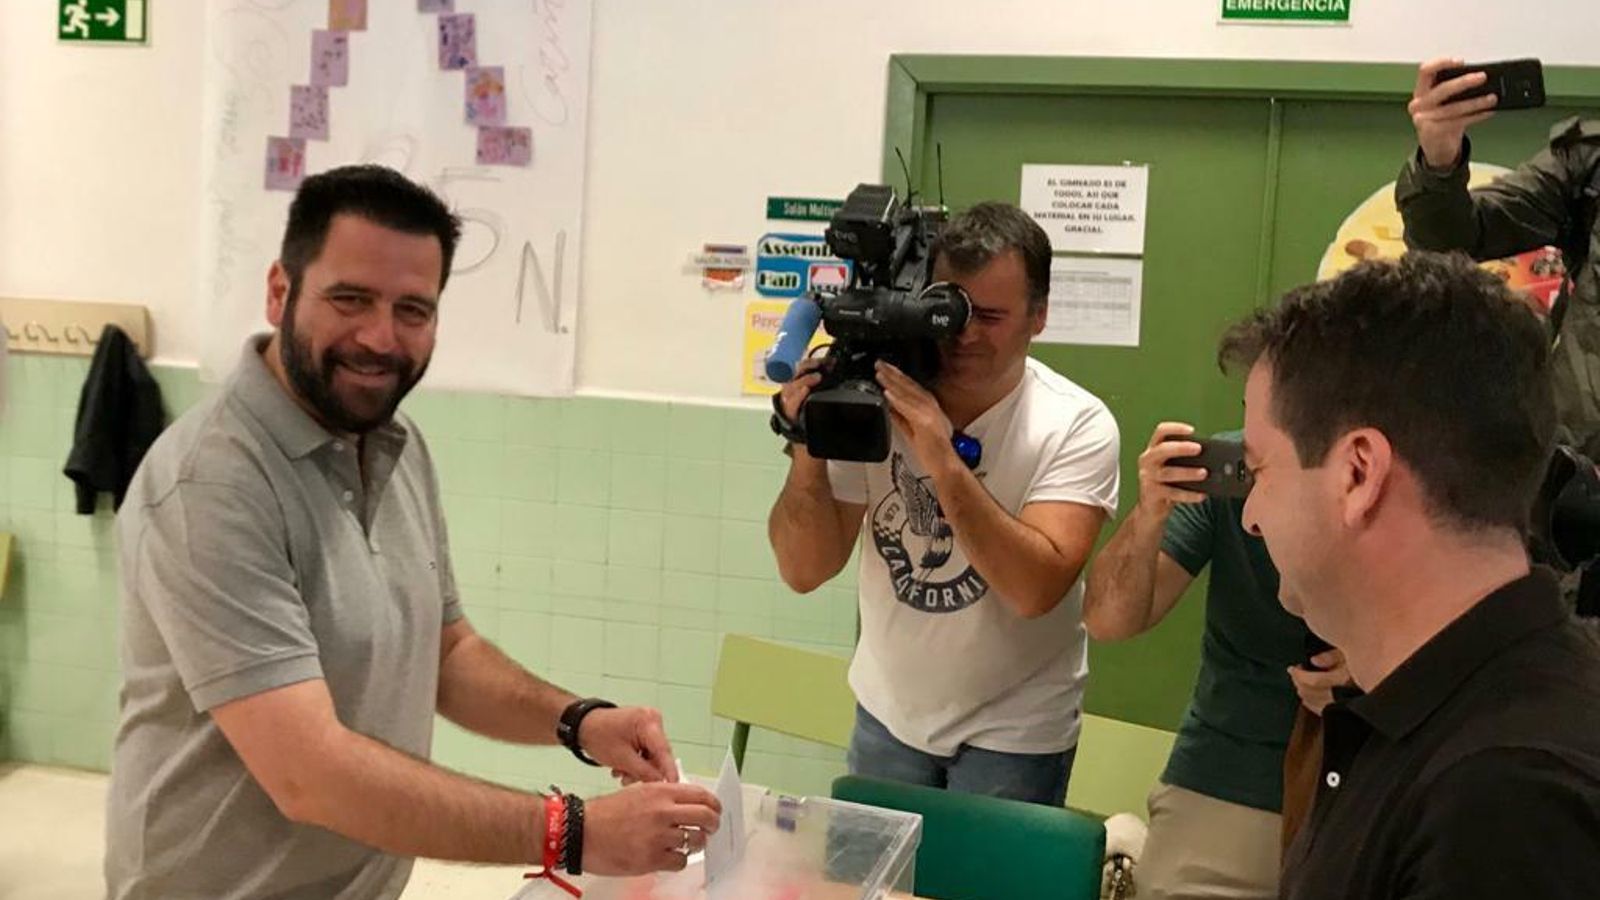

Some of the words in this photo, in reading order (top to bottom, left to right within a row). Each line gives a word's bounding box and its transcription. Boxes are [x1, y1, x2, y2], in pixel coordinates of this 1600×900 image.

[1226, 0, 1345, 11] EMERGENCIA
[1052, 201, 1093, 210] COLOCAR
[1095, 202, 1120, 210] CADA
[760, 242, 834, 257] Assemb
[760, 272, 798, 288] Hall
[882, 546, 984, 608] CALIFORNI
